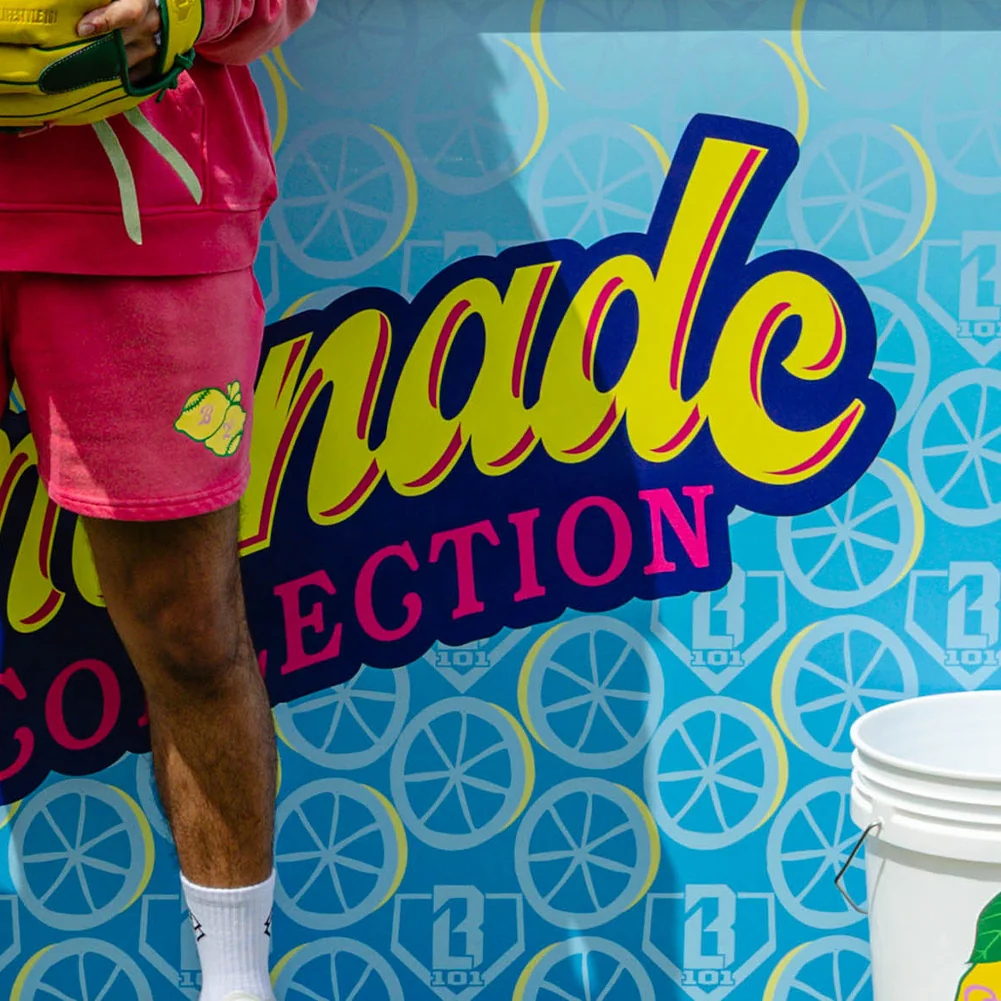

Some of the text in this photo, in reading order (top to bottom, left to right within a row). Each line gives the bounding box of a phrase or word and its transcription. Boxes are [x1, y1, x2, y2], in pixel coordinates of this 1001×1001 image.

[957, 321, 1001, 338] 10
[435, 649, 491, 667] 101
[691, 650, 744, 667] 101
[944, 649, 1000, 666] 101
[430, 970, 486, 987] 101
[681, 970, 737, 987] 101
